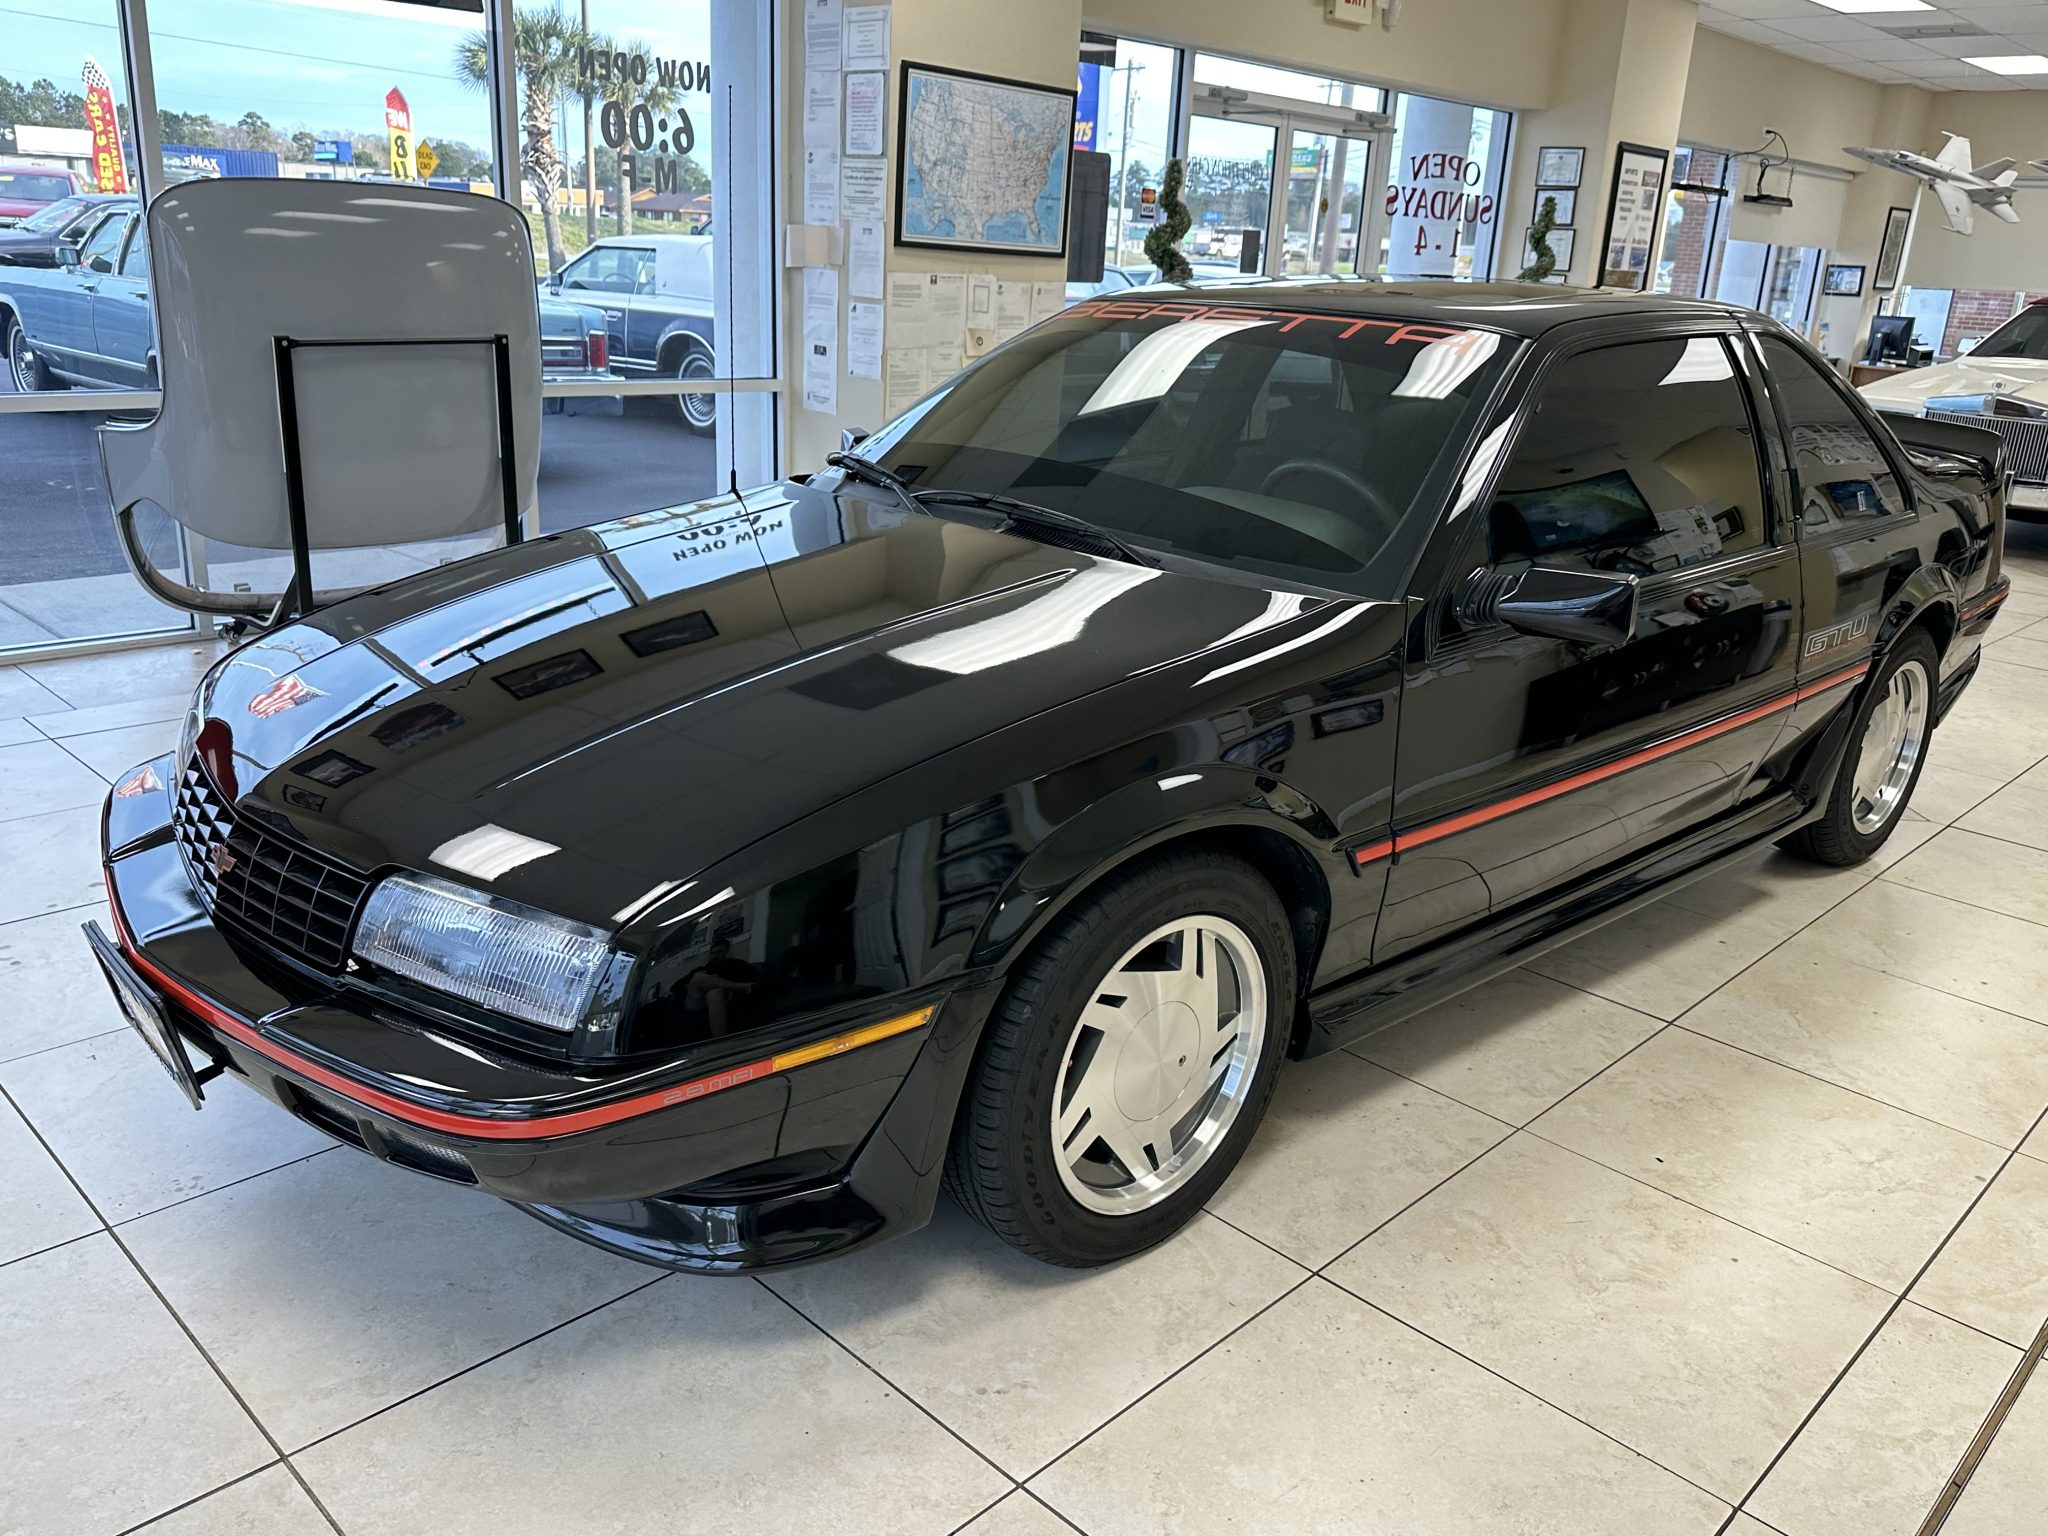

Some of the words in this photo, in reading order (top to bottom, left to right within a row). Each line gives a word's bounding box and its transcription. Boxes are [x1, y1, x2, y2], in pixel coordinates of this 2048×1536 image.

[417, 151, 433, 161] DEAD
[420, 161, 432, 171] END
[1057, 301, 1478, 356] BERETTA
[1804, 614, 1870, 657] GTU
